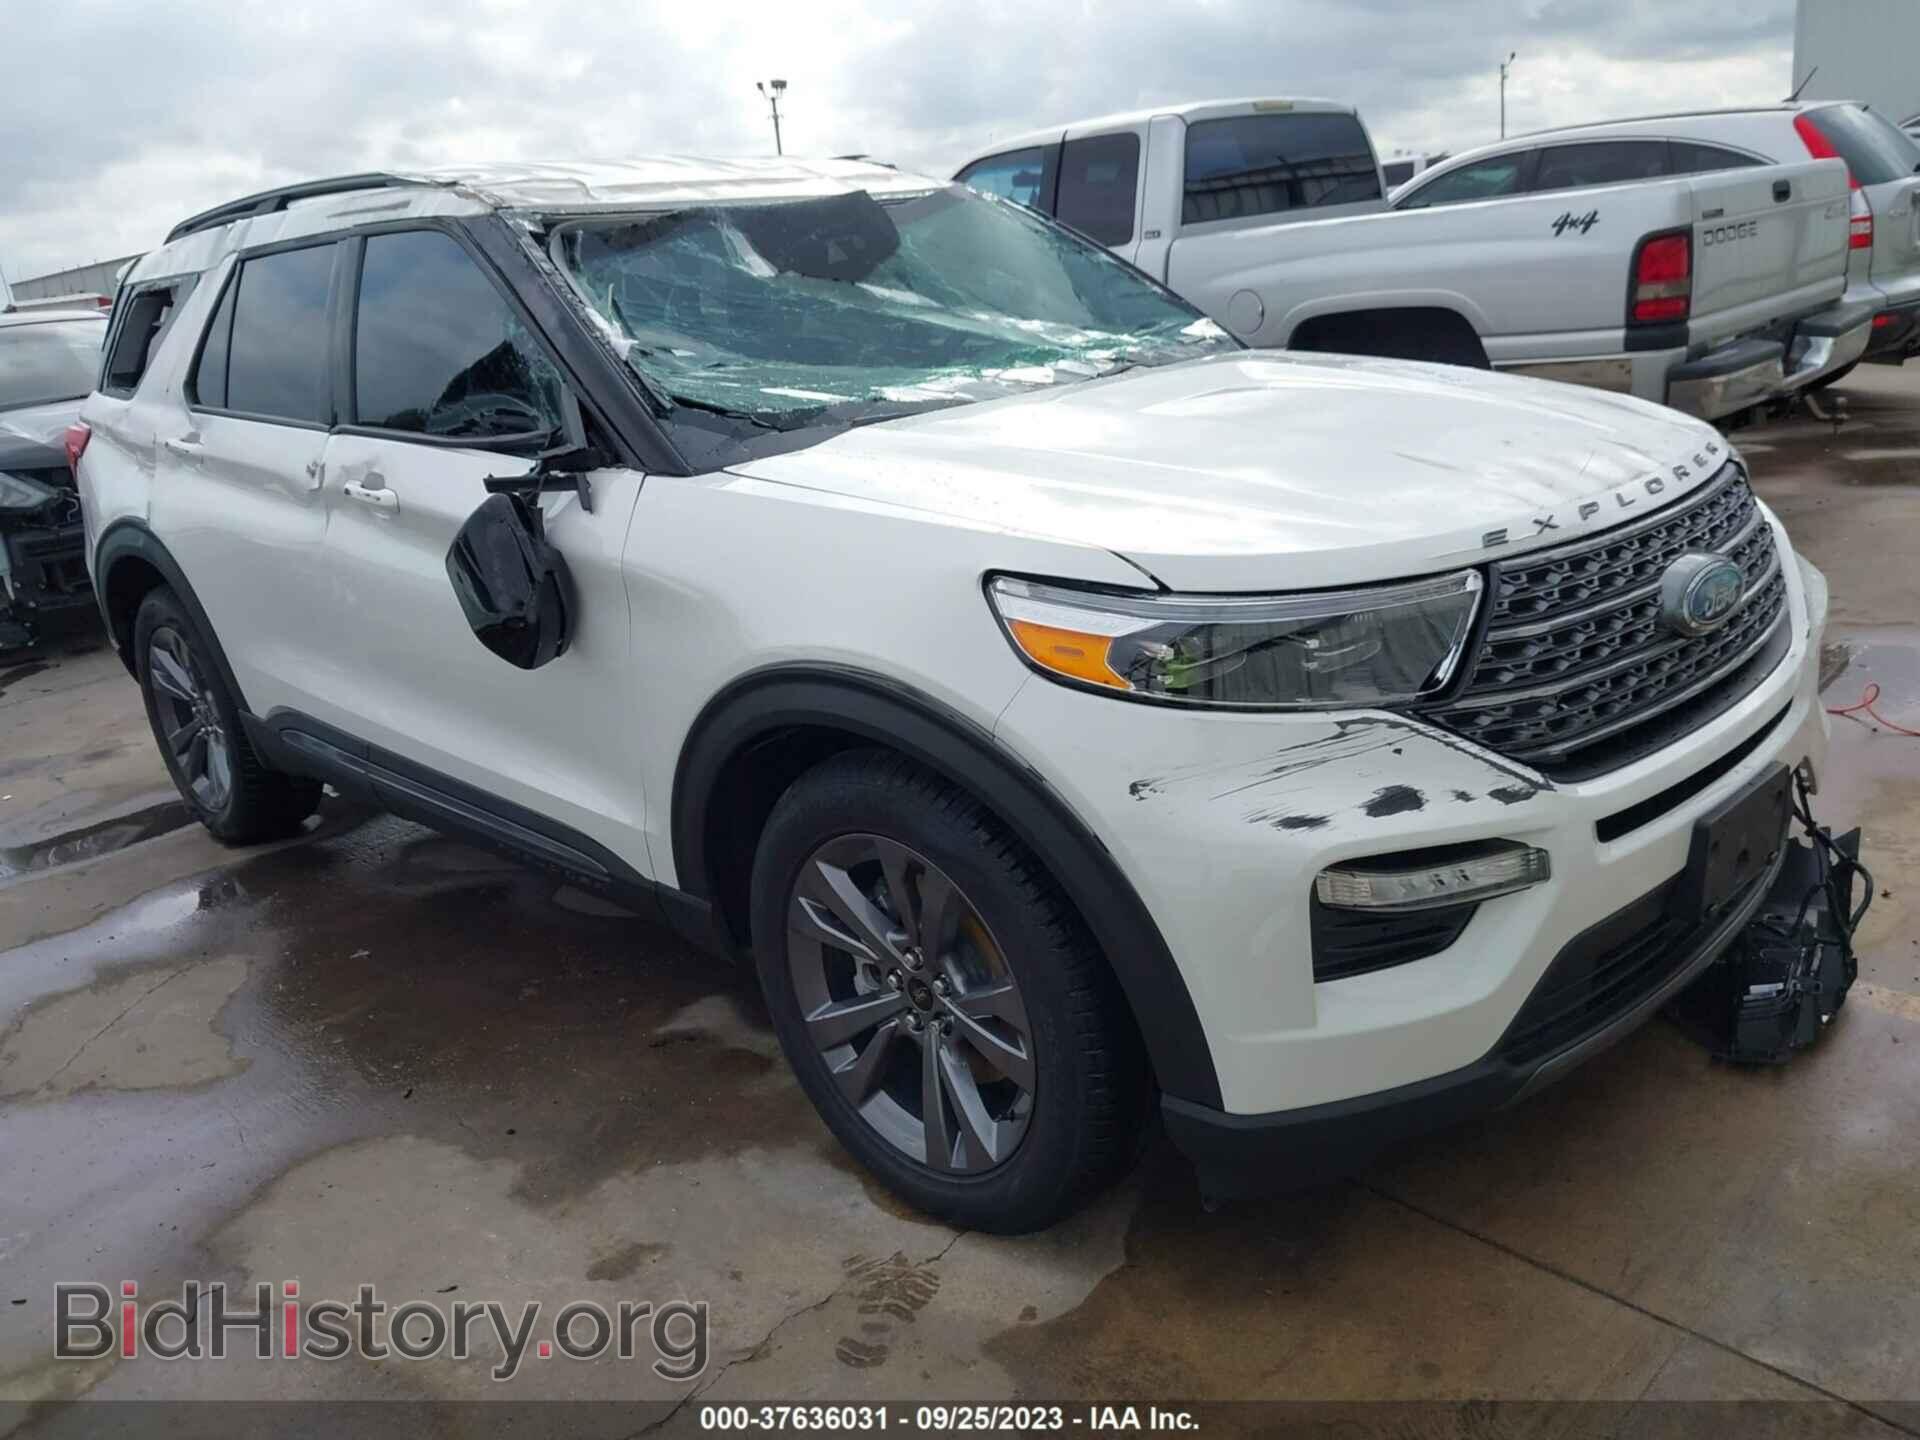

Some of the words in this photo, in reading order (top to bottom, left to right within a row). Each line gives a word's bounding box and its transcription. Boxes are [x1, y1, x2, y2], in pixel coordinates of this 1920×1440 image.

[1703, 220, 1758, 247] DODGE
[1481, 441, 1719, 548] EXPLORER
[1695, 580, 1739, 618] Ford
